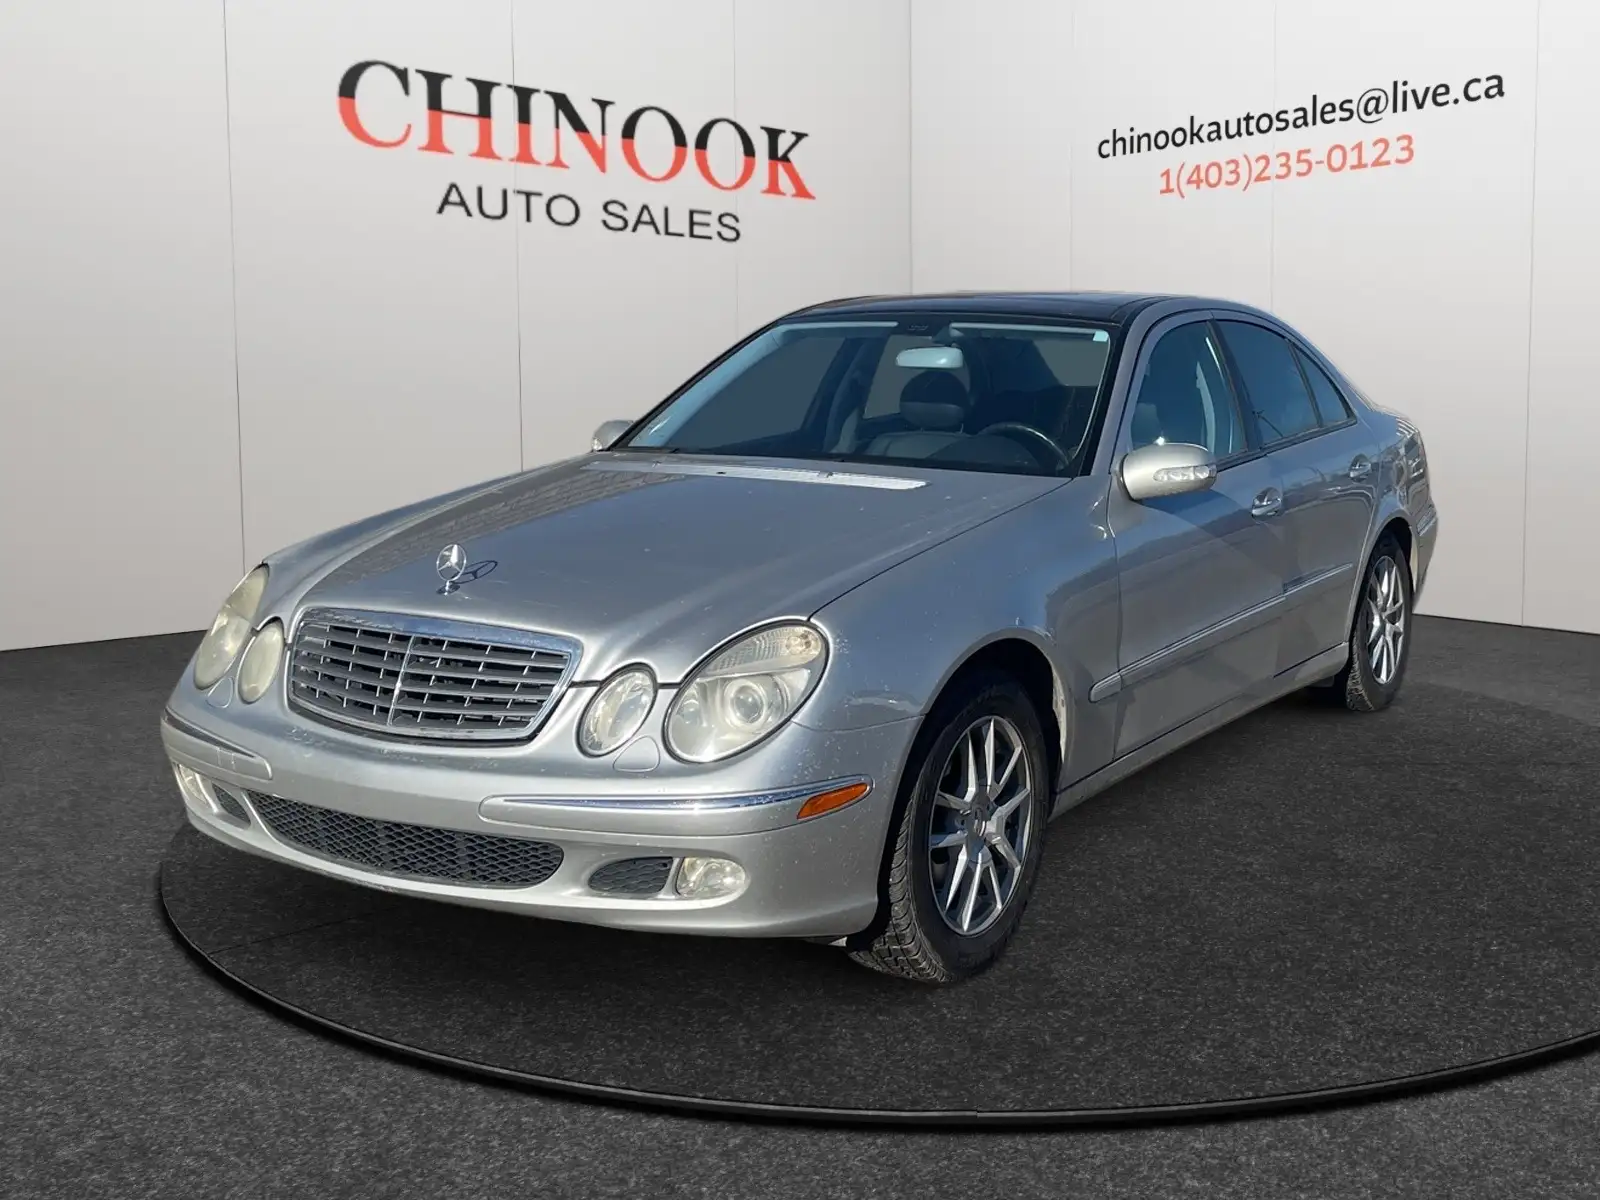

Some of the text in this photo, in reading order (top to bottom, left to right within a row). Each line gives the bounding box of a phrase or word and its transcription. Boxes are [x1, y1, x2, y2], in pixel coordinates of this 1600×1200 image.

[337, 59, 816, 200] CHINOOK
[1097, 73, 1505, 159] chinookautosales@live.ca
[1158, 133, 1415, 199] 1(403)235-0123
[436, 182, 741, 243] AUTO SALES
